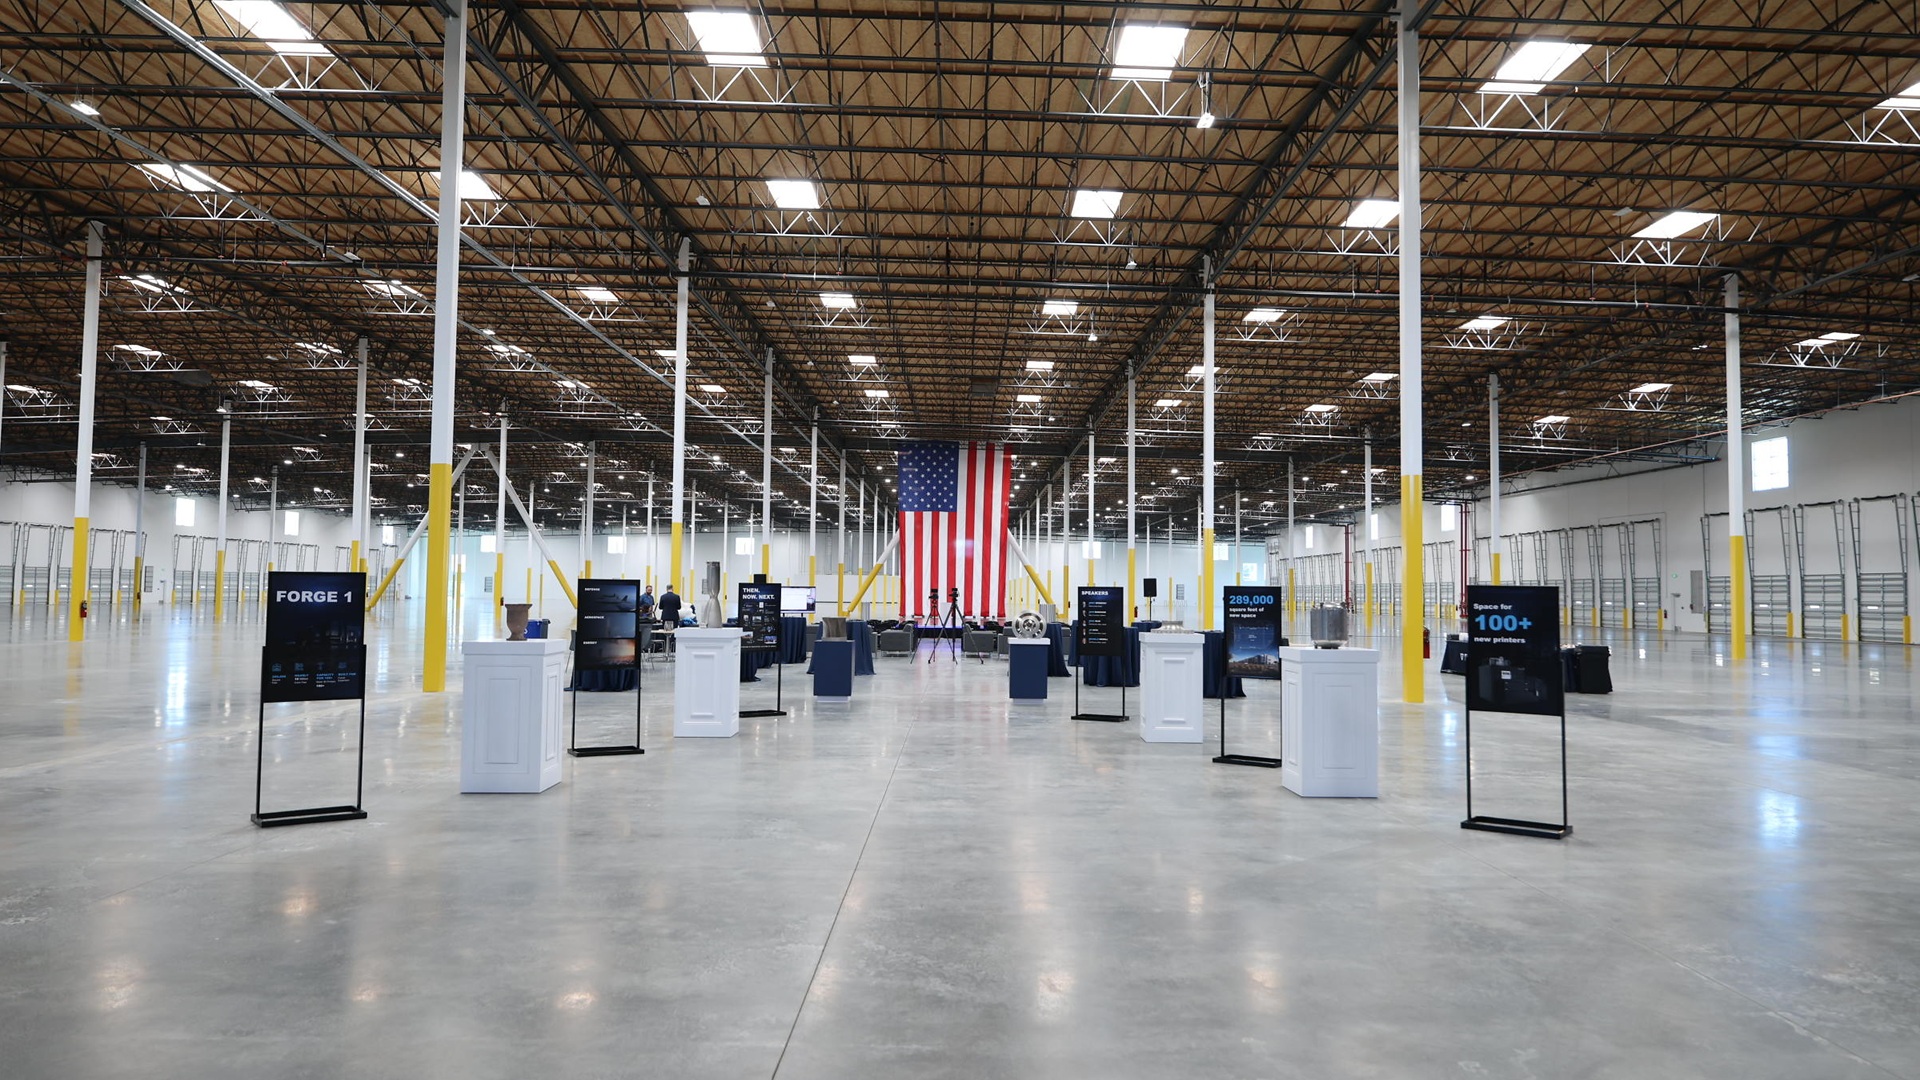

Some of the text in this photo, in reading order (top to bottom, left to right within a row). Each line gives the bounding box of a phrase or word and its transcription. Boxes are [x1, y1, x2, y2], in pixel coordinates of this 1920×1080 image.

[276, 590, 352, 603] FORGE 1
[1229, 595, 1273, 606] 289,000
[1475, 614, 1532, 631] 100+
[1493, 636, 1526, 644] printers
